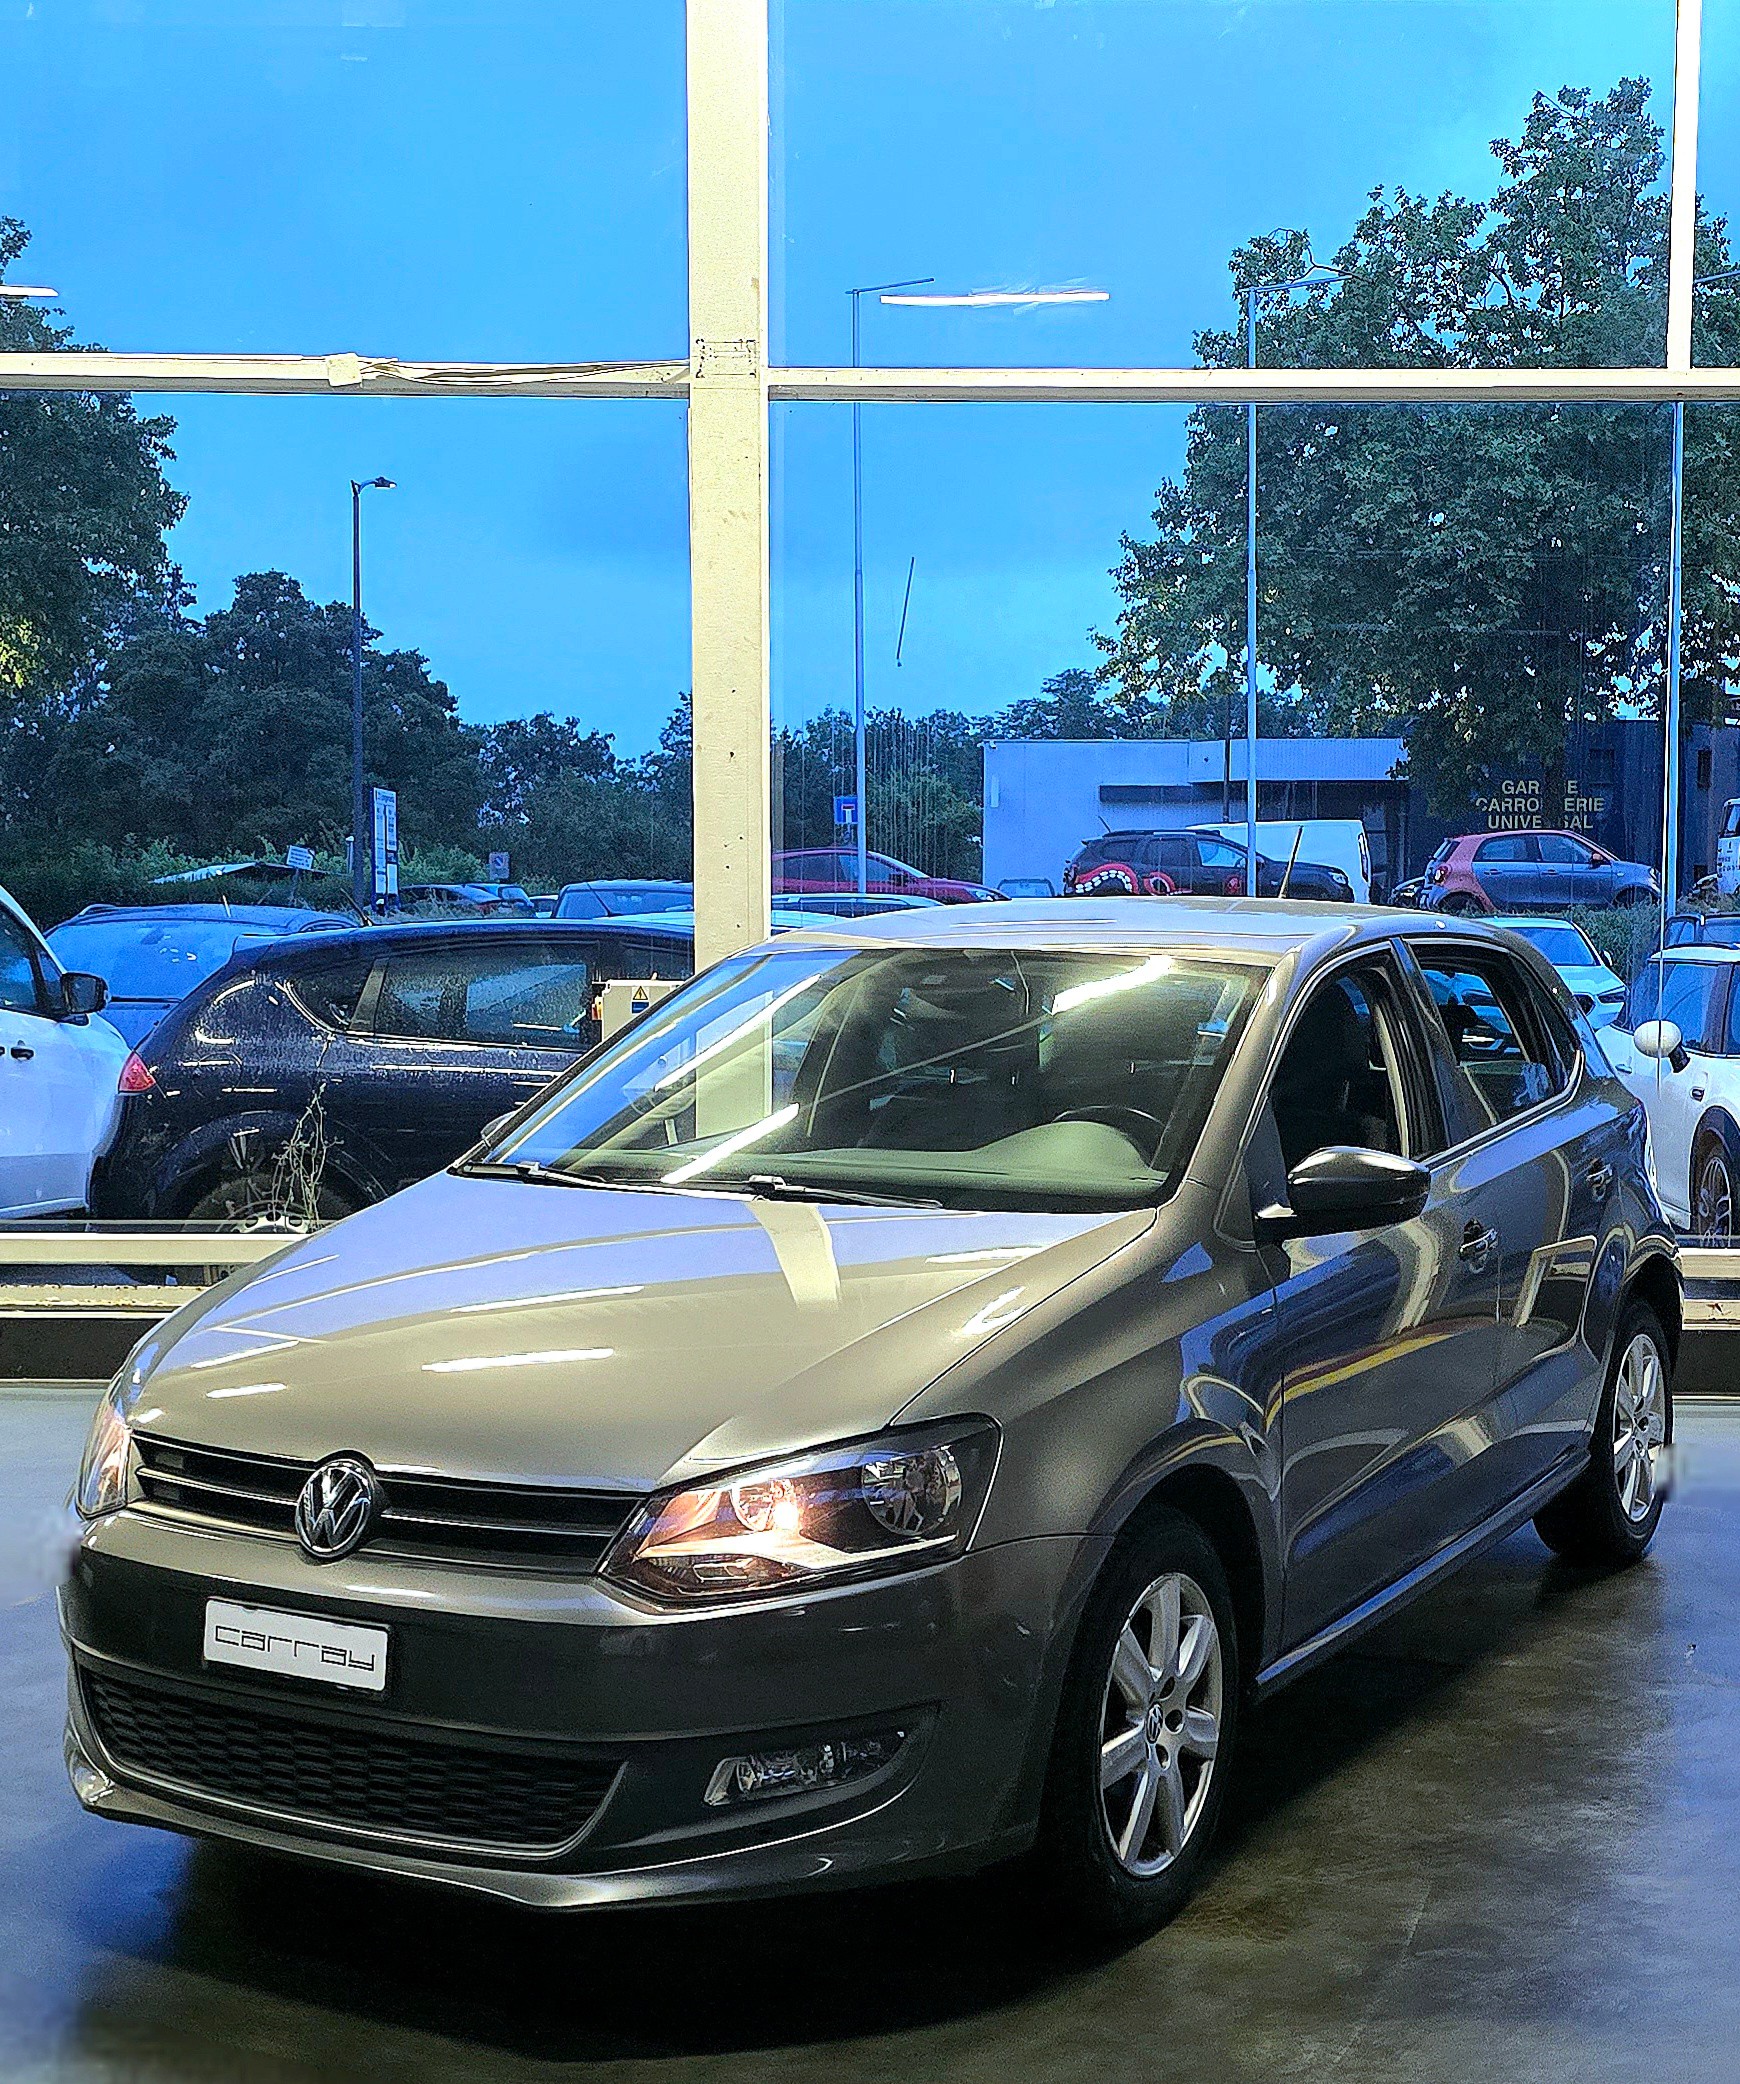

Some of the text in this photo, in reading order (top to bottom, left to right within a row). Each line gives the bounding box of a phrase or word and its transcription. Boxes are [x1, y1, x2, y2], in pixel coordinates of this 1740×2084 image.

[1501, 780, 1578, 795] GARE
[1475, 797, 1605, 812] CARROERIE
[215, 1625, 375, 1672] carray
